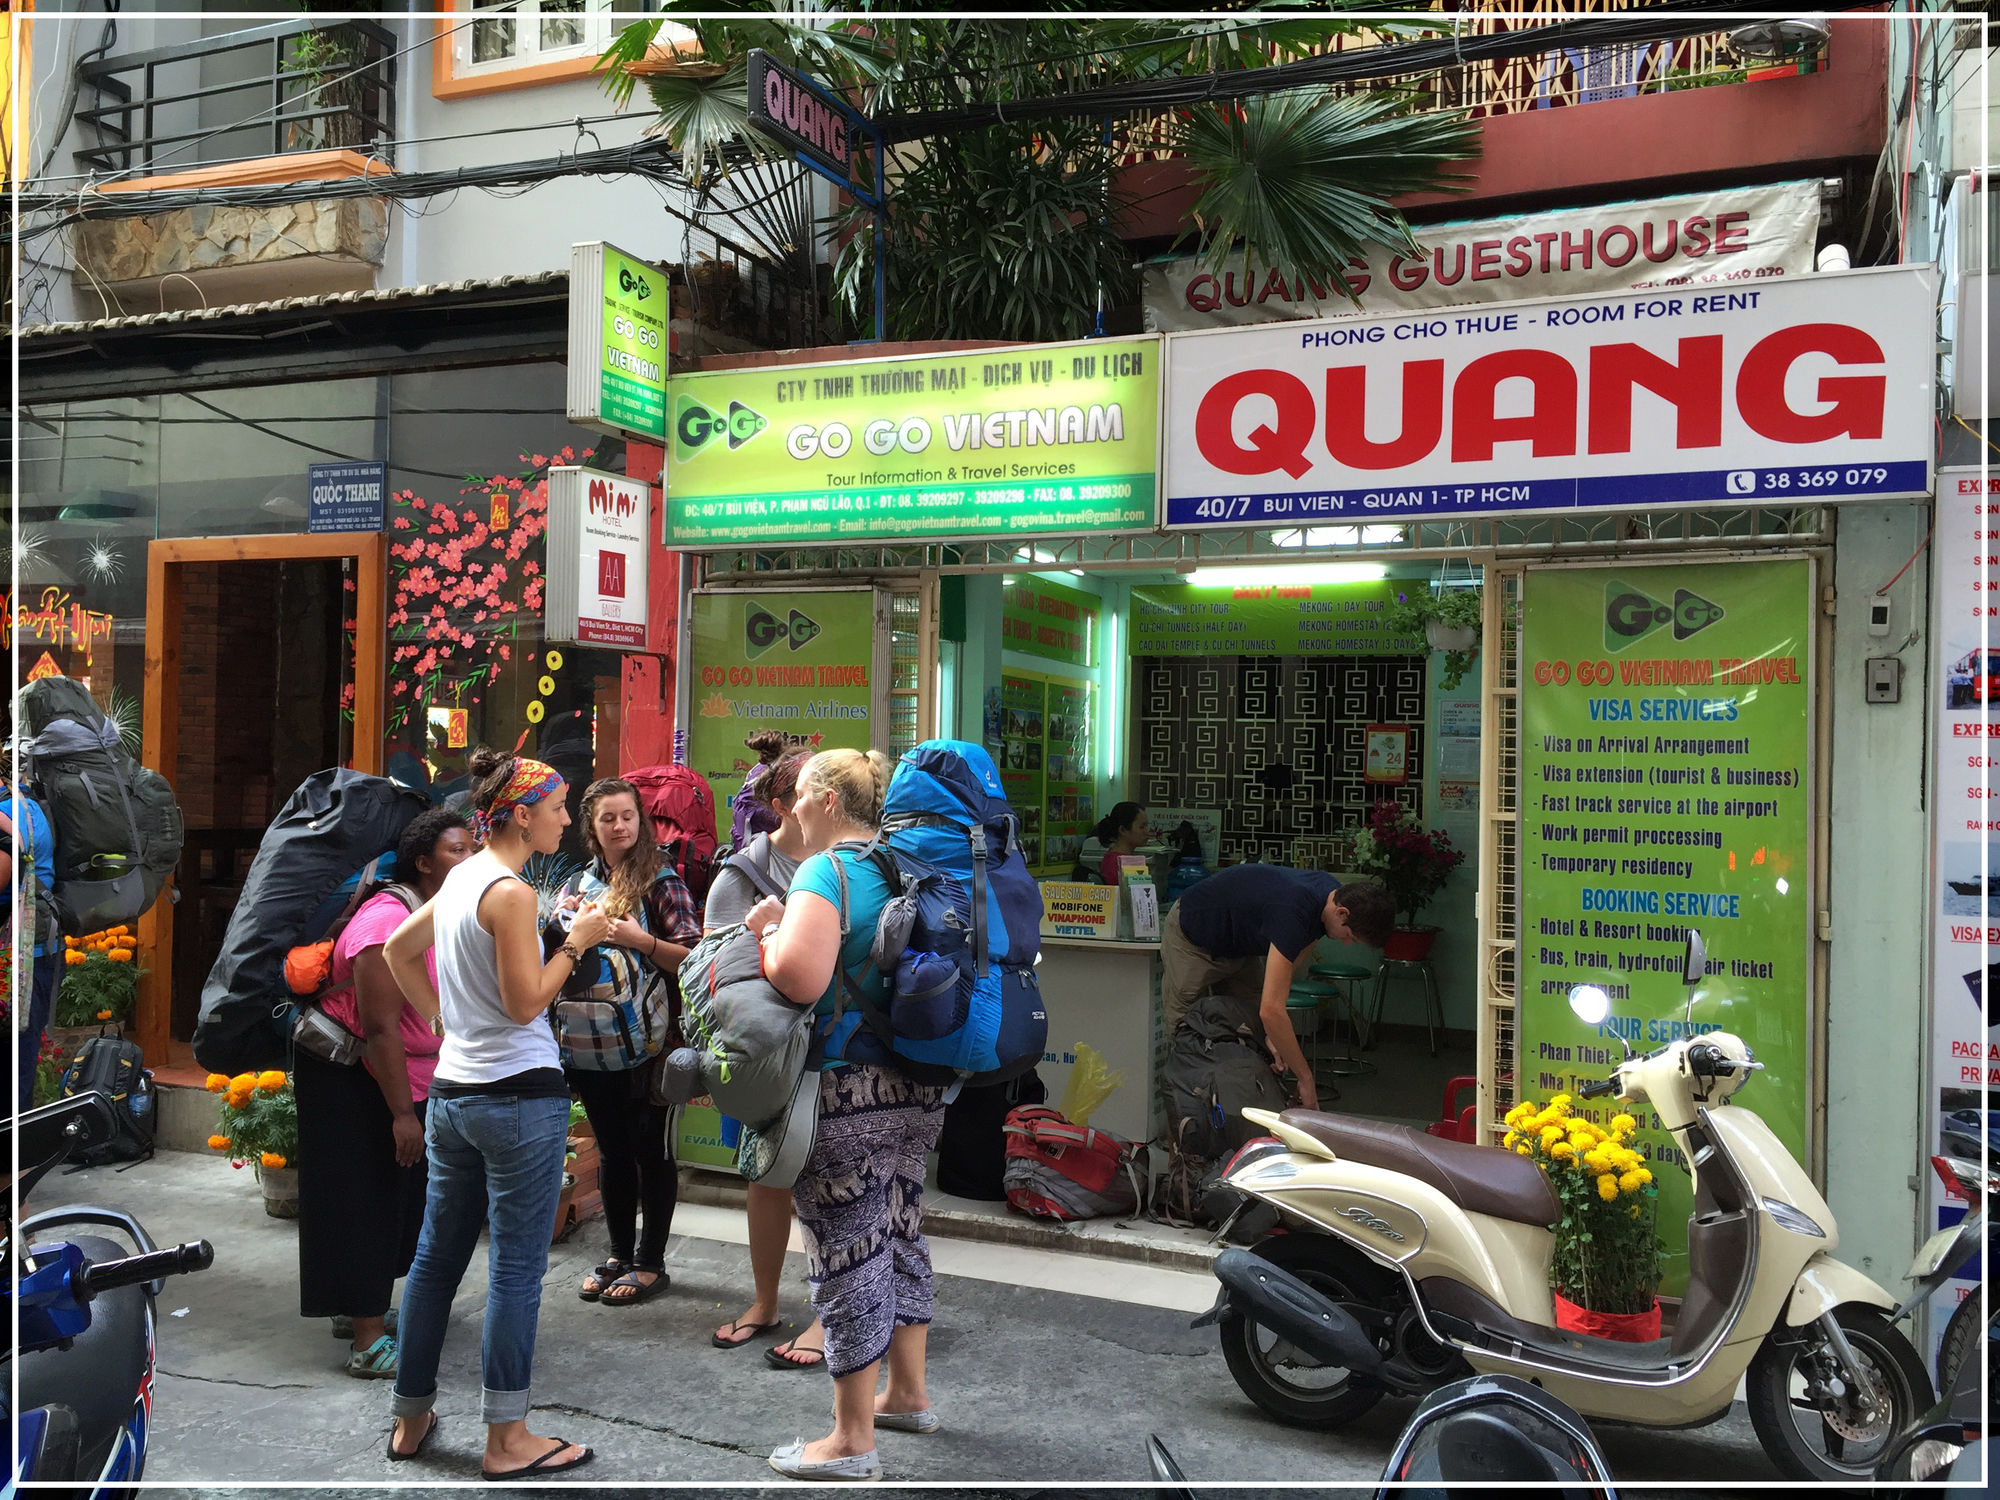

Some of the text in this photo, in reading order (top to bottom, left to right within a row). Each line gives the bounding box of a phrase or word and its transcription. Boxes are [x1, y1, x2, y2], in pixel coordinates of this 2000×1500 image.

[765, 69, 846, 163] QUANG
[1388, 211, 1750, 291] GUESTHOUSE
[1302, 291, 1761, 348] PHONG CHO THUE ROOM FOR RENT
[613, 315, 659, 350] GO GO
[607, 345, 660, 383] VIETNAM
[777, 352, 1142, 403] CTY TNHH THƯƠNG MẠI DỊCH VỤ DU LỊCH
[1195, 322, 1886, 481] QUANG
[786, 402, 1125, 461] GO GO VIETNAM
[826, 462, 1076, 487] Tour Information & Travel Services
[1764, 468, 1888, 489] 38 369 079
[344, 483, 380, 502] THANH
[702, 502, 724, 516] 40/7
[726, 498, 742, 515] BÙI
[770, 500, 779, 513] P.
[781, 498, 810, 516] PHẠM
[811, 495, 830, 512] NGŨ
[832, 494, 853, 513] LÃO,
[856, 495, 871, 511] Q.1
[898, 493, 913, 508] 08.
[1033, 487, 1057, 502] FAX:
[1059, 486, 1075, 501] 08.
[1079, 484, 1132, 501] 39209300
[1195, 486, 1531, 519] 40/7 BUI VIEN QUAN TP HCM
[602, 516, 622, 528] HOTEL
[673, 507, 1145, 539] Website: www.gogovietnamtravel.com Email: info@gogovietnamtravel.com gogovina.travel@gmail.com
[1190, 603, 1206, 614] CITY
[1210, 603, 1229, 614] TOUR
[1299, 602, 1333, 613] MEKONG
[1344, 601, 1361, 612] DAY
[1364, 601, 1385, 612] TOUR
[1139, 622, 1149, 632] CU
[1151, 622, 1164, 632] CHI
[1167, 622, 1200, 633] TUNNELS
[1228, 621, 1247, 632] DAY)
[1298, 620, 1379, 631] MEKONG HOMESTAY
[1138, 640, 1153, 650] CAO
[1156, 640, 1168, 650] DAI
[1171, 640, 1200, 650] TEMPLE
[1212, 640, 1222, 650] CU
[1225, 640, 1238, 650] CHI
[1241, 639, 1276, 650] TUNNELS
[1298, 639, 1380, 650] MEKONG HOMESTAY
[701, 664, 869, 688] GO GO VIETNAM TRAVEL
[1533, 656, 1801, 687] GO GO VIETNAM TRAVEL
[733, 699, 868, 720] Vietnam Airlines
[1588, 697, 1739, 722] VISA SERVICES
[1543, 735, 1750, 757] Visa on Arrival Arrangement
[1386, 752, 1402, 765] 24
[1543, 764, 1800, 789] Visa extension (tourist & business)
[1541, 794, 1778, 819] Fast track service at the airport
[1541, 823, 1722, 850] Work permit proccessing
[1541, 853, 1693, 880] Temporary residency
[1044, 884, 1111, 901] SALE SIM CARD
[1581, 887, 1740, 919] BOOKING SERVICE
[1048, 912, 1105, 925] VINAPHONE
[1051, 902, 1103, 913] MOBIFONE
[1055, 924, 1096, 936] VIETTEL
[1540, 917, 1641, 940] Hotel & Resort
[1951, 925, 1982, 941] VISA
[1540, 947, 1774, 980] Bus, train, hydrofoil air ticket
[1539, 1042, 1611, 1065] Phan Thiet
[1539, 1072, 1564, 1091] Nha
[1651, 1112, 1660, 1131] 3
[1643, 1142, 1652, 1161] 3
